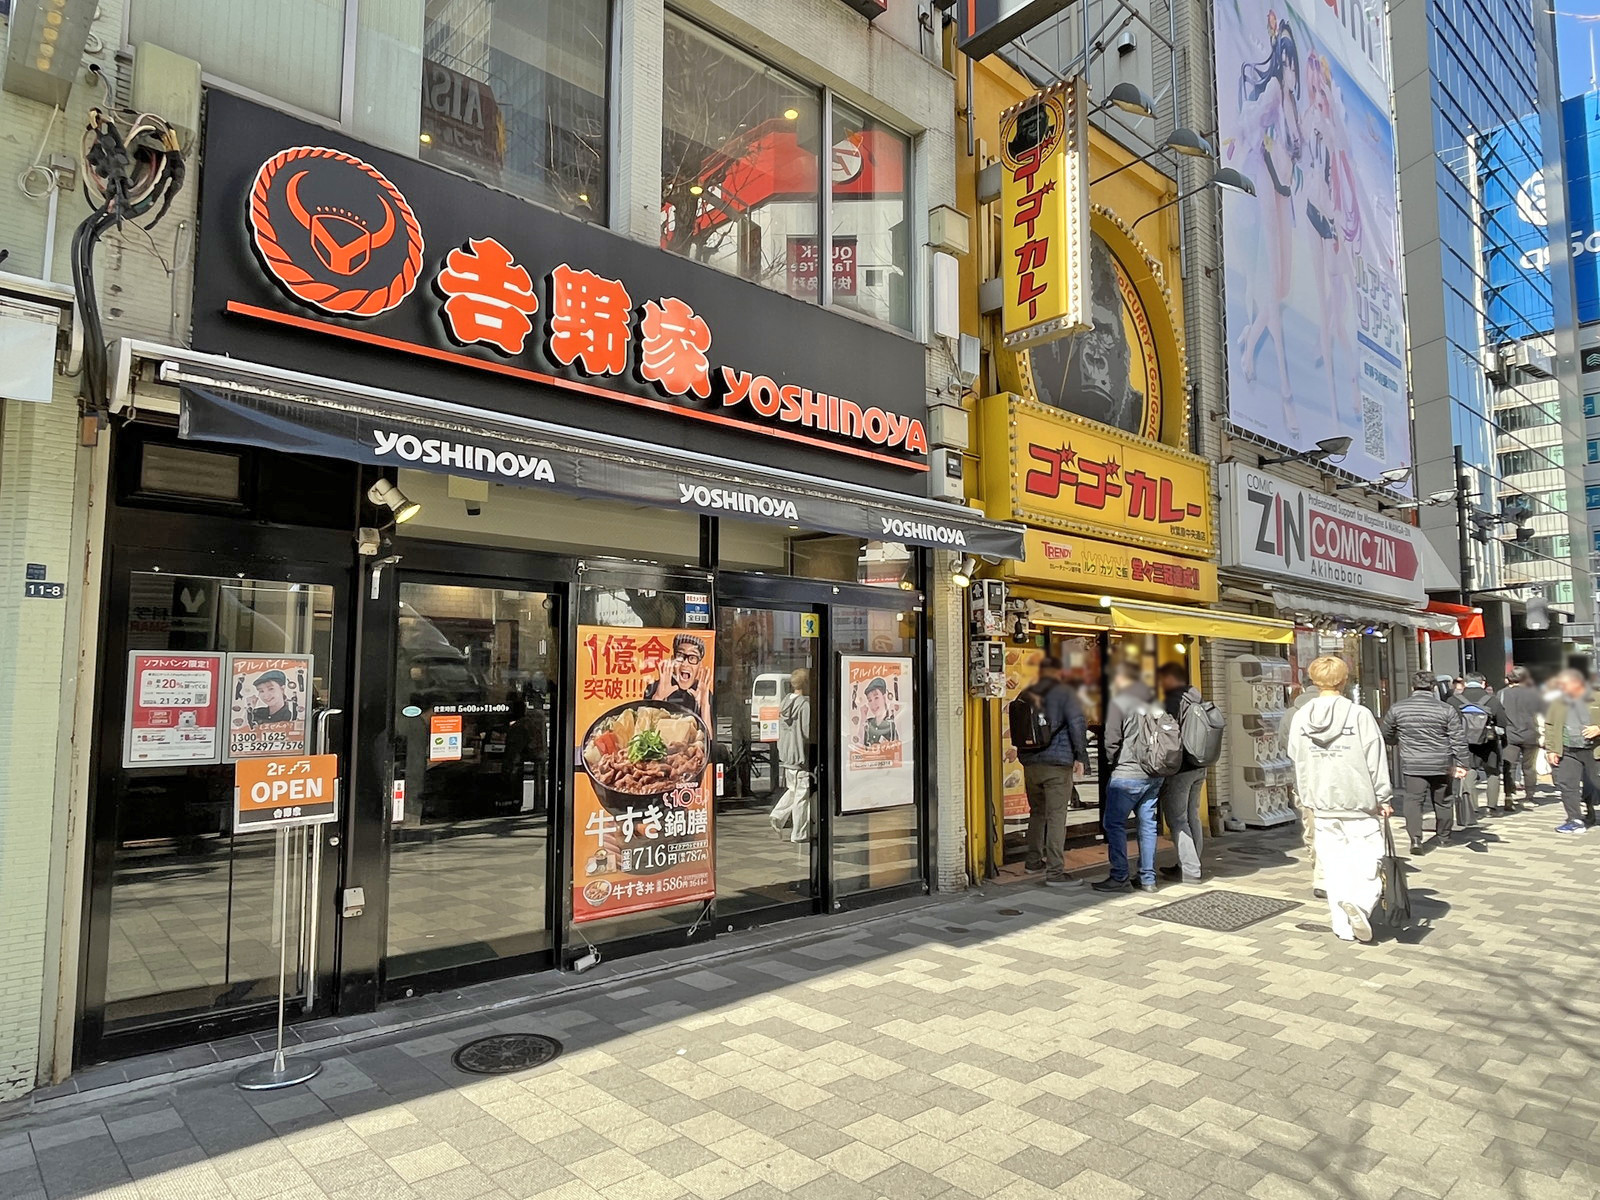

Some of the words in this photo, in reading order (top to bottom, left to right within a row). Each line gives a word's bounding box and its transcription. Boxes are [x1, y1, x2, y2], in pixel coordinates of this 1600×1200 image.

[1013, 131, 1057, 321] ゴーゴーカレー
[437, 236, 712, 398] 吉野家
[721, 365, 928, 455] YOSHINOYA
[373, 430, 556, 483] YOSHINOYA
[1025, 441, 1202, 524] ゴーゴーカレー
[1247, 474, 1273, 495] COMIC
[678, 483, 799, 520] YOSHINOYA
[1308, 494, 1338, 512] Professional
[1338, 503, 1356, 519] Support
[881, 515, 966, 548] YOSHINOYA
[1247, 489, 1305, 569] ZIN
[1311, 516, 1372, 567] COMIC
[1374, 535, 1396, 573] ZIN
[1310, 559, 1363, 585] Akihabara
[231, 741, 304, 752] 03-5297-7576
[232, 733, 257, 742] 1300
[262, 731, 287, 741] 1625
[266, 762, 286, 776] 2F
[250, 777, 323, 804] OPEN
[584, 804, 708, 847] 牛すき鍋膳
